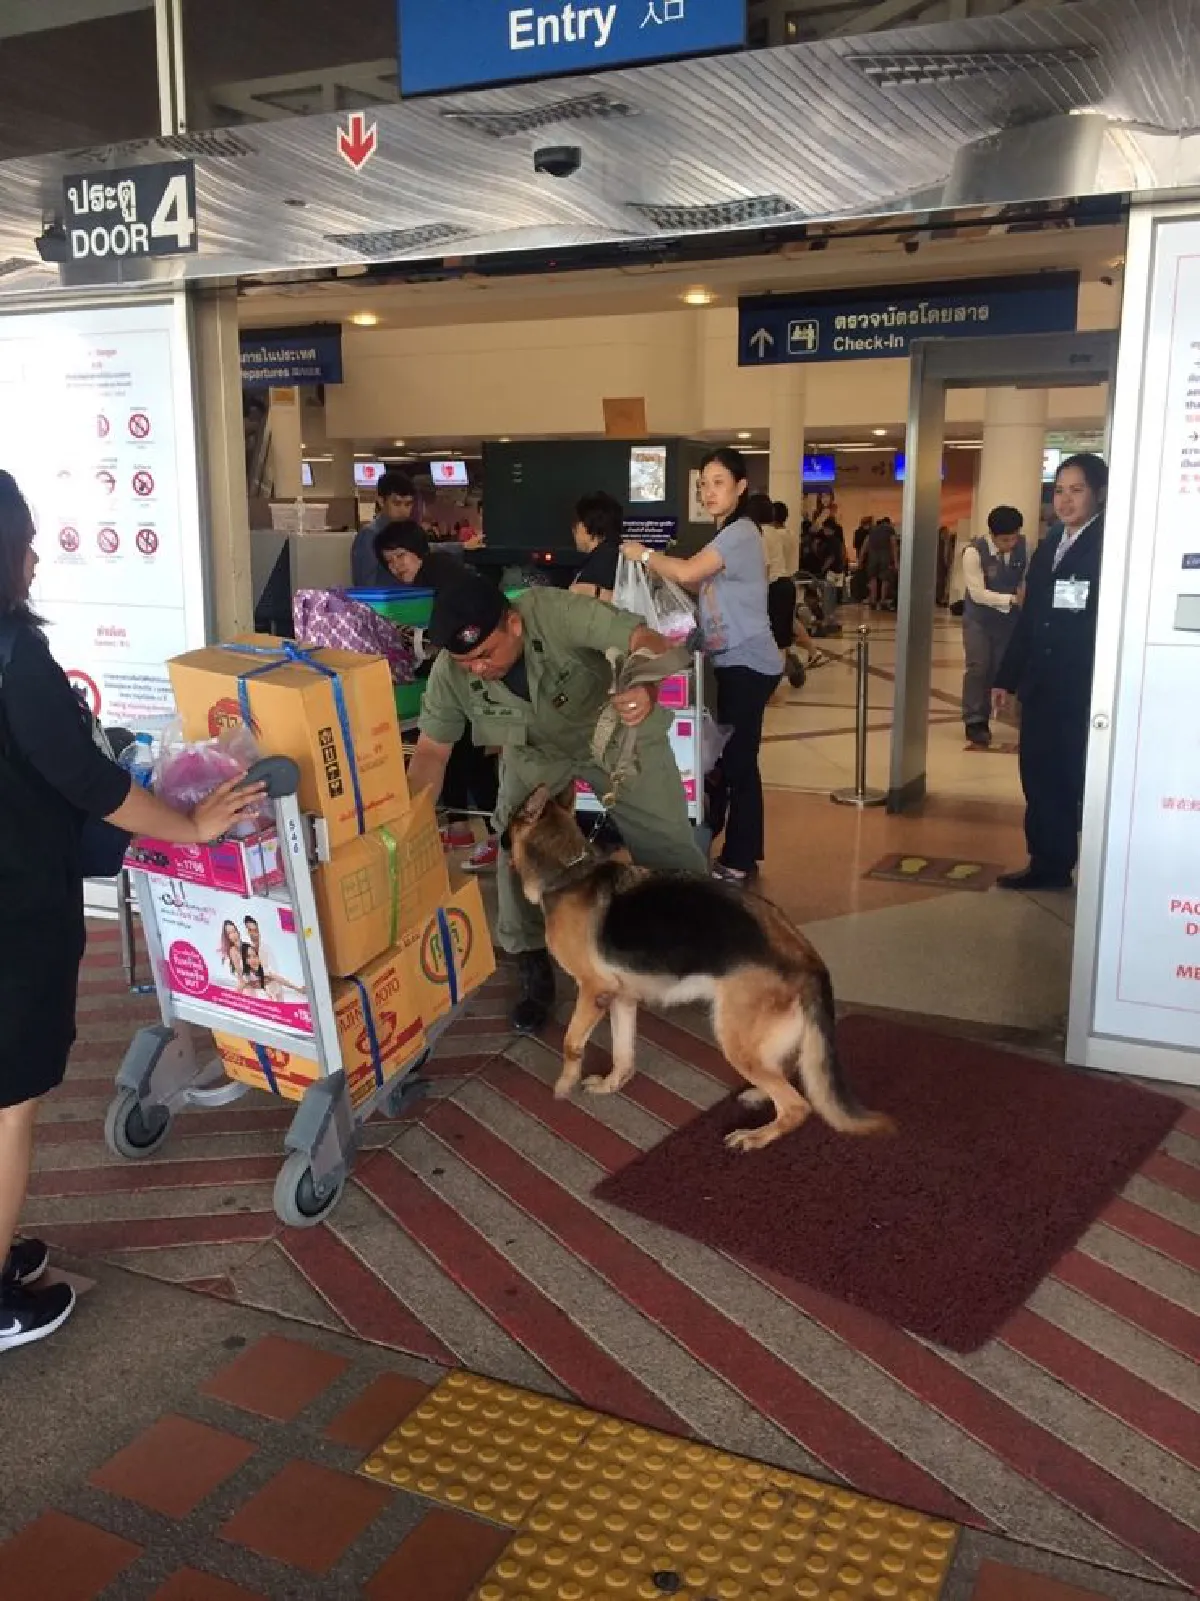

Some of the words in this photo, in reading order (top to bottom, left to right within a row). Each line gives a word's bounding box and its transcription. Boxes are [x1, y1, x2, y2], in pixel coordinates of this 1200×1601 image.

[508, 3, 616, 50] Entry
[639, 0, 684, 28] 入口
[67, 179, 137, 222] ประตู
[151, 175, 194, 248] 4
[71, 222, 149, 258] DOOR
[834, 302, 990, 330] ตรวจบัตรโดยสาร
[240, 367, 290, 381] epartures
